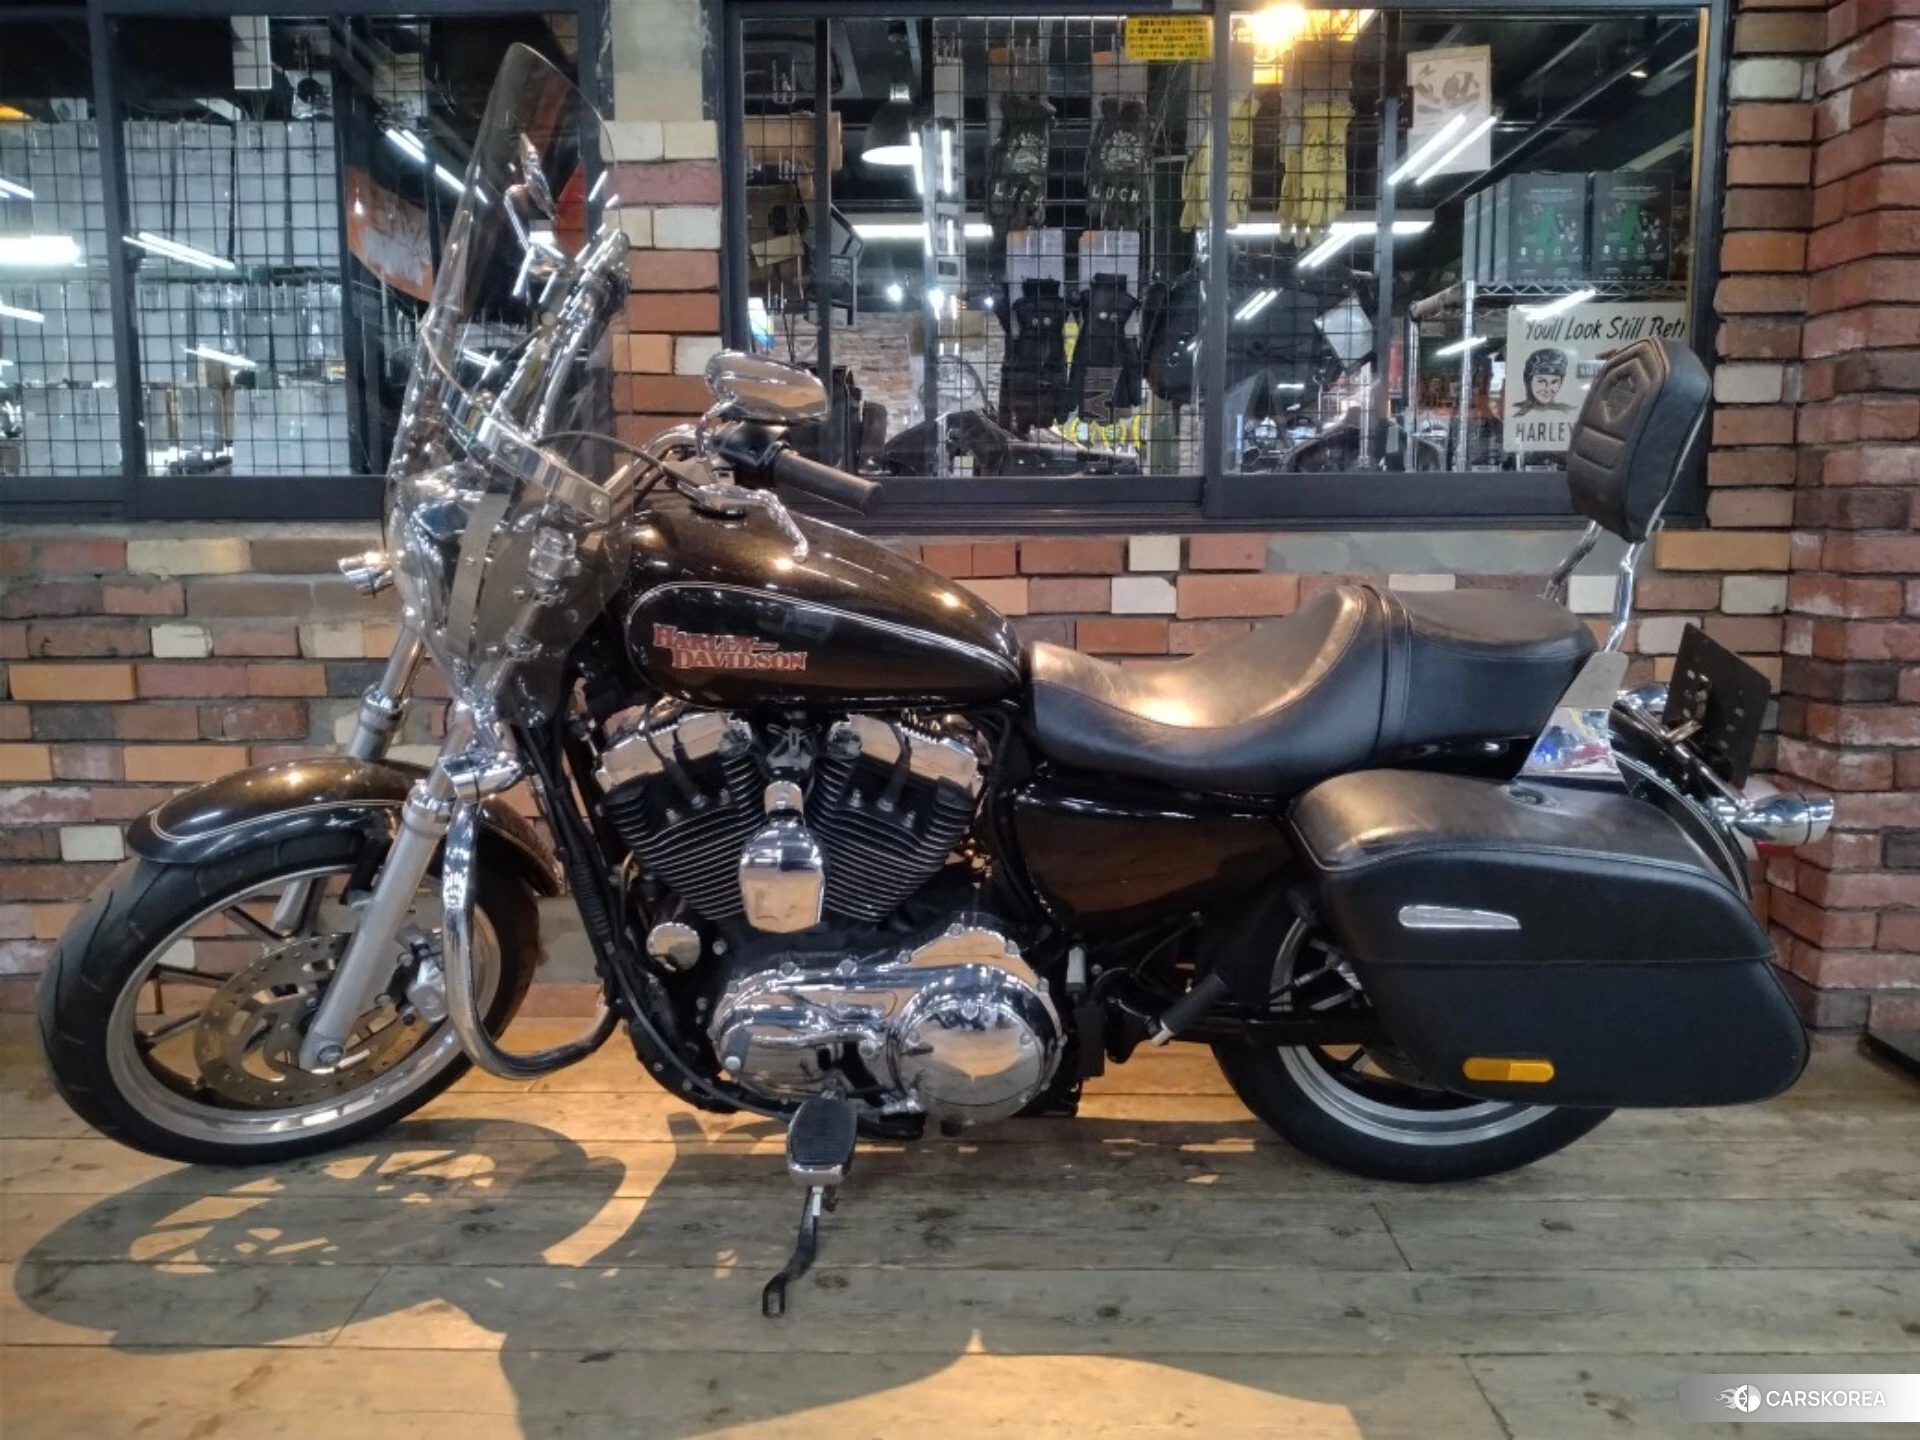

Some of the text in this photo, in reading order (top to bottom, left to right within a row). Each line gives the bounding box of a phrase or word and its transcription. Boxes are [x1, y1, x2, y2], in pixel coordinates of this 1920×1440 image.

[1091, 185, 1140, 202] LUCK
[1564, 315, 1603, 341] Look
[1606, 315, 1645, 340] Still
[672, 650, 808, 670] DAVIDSON
